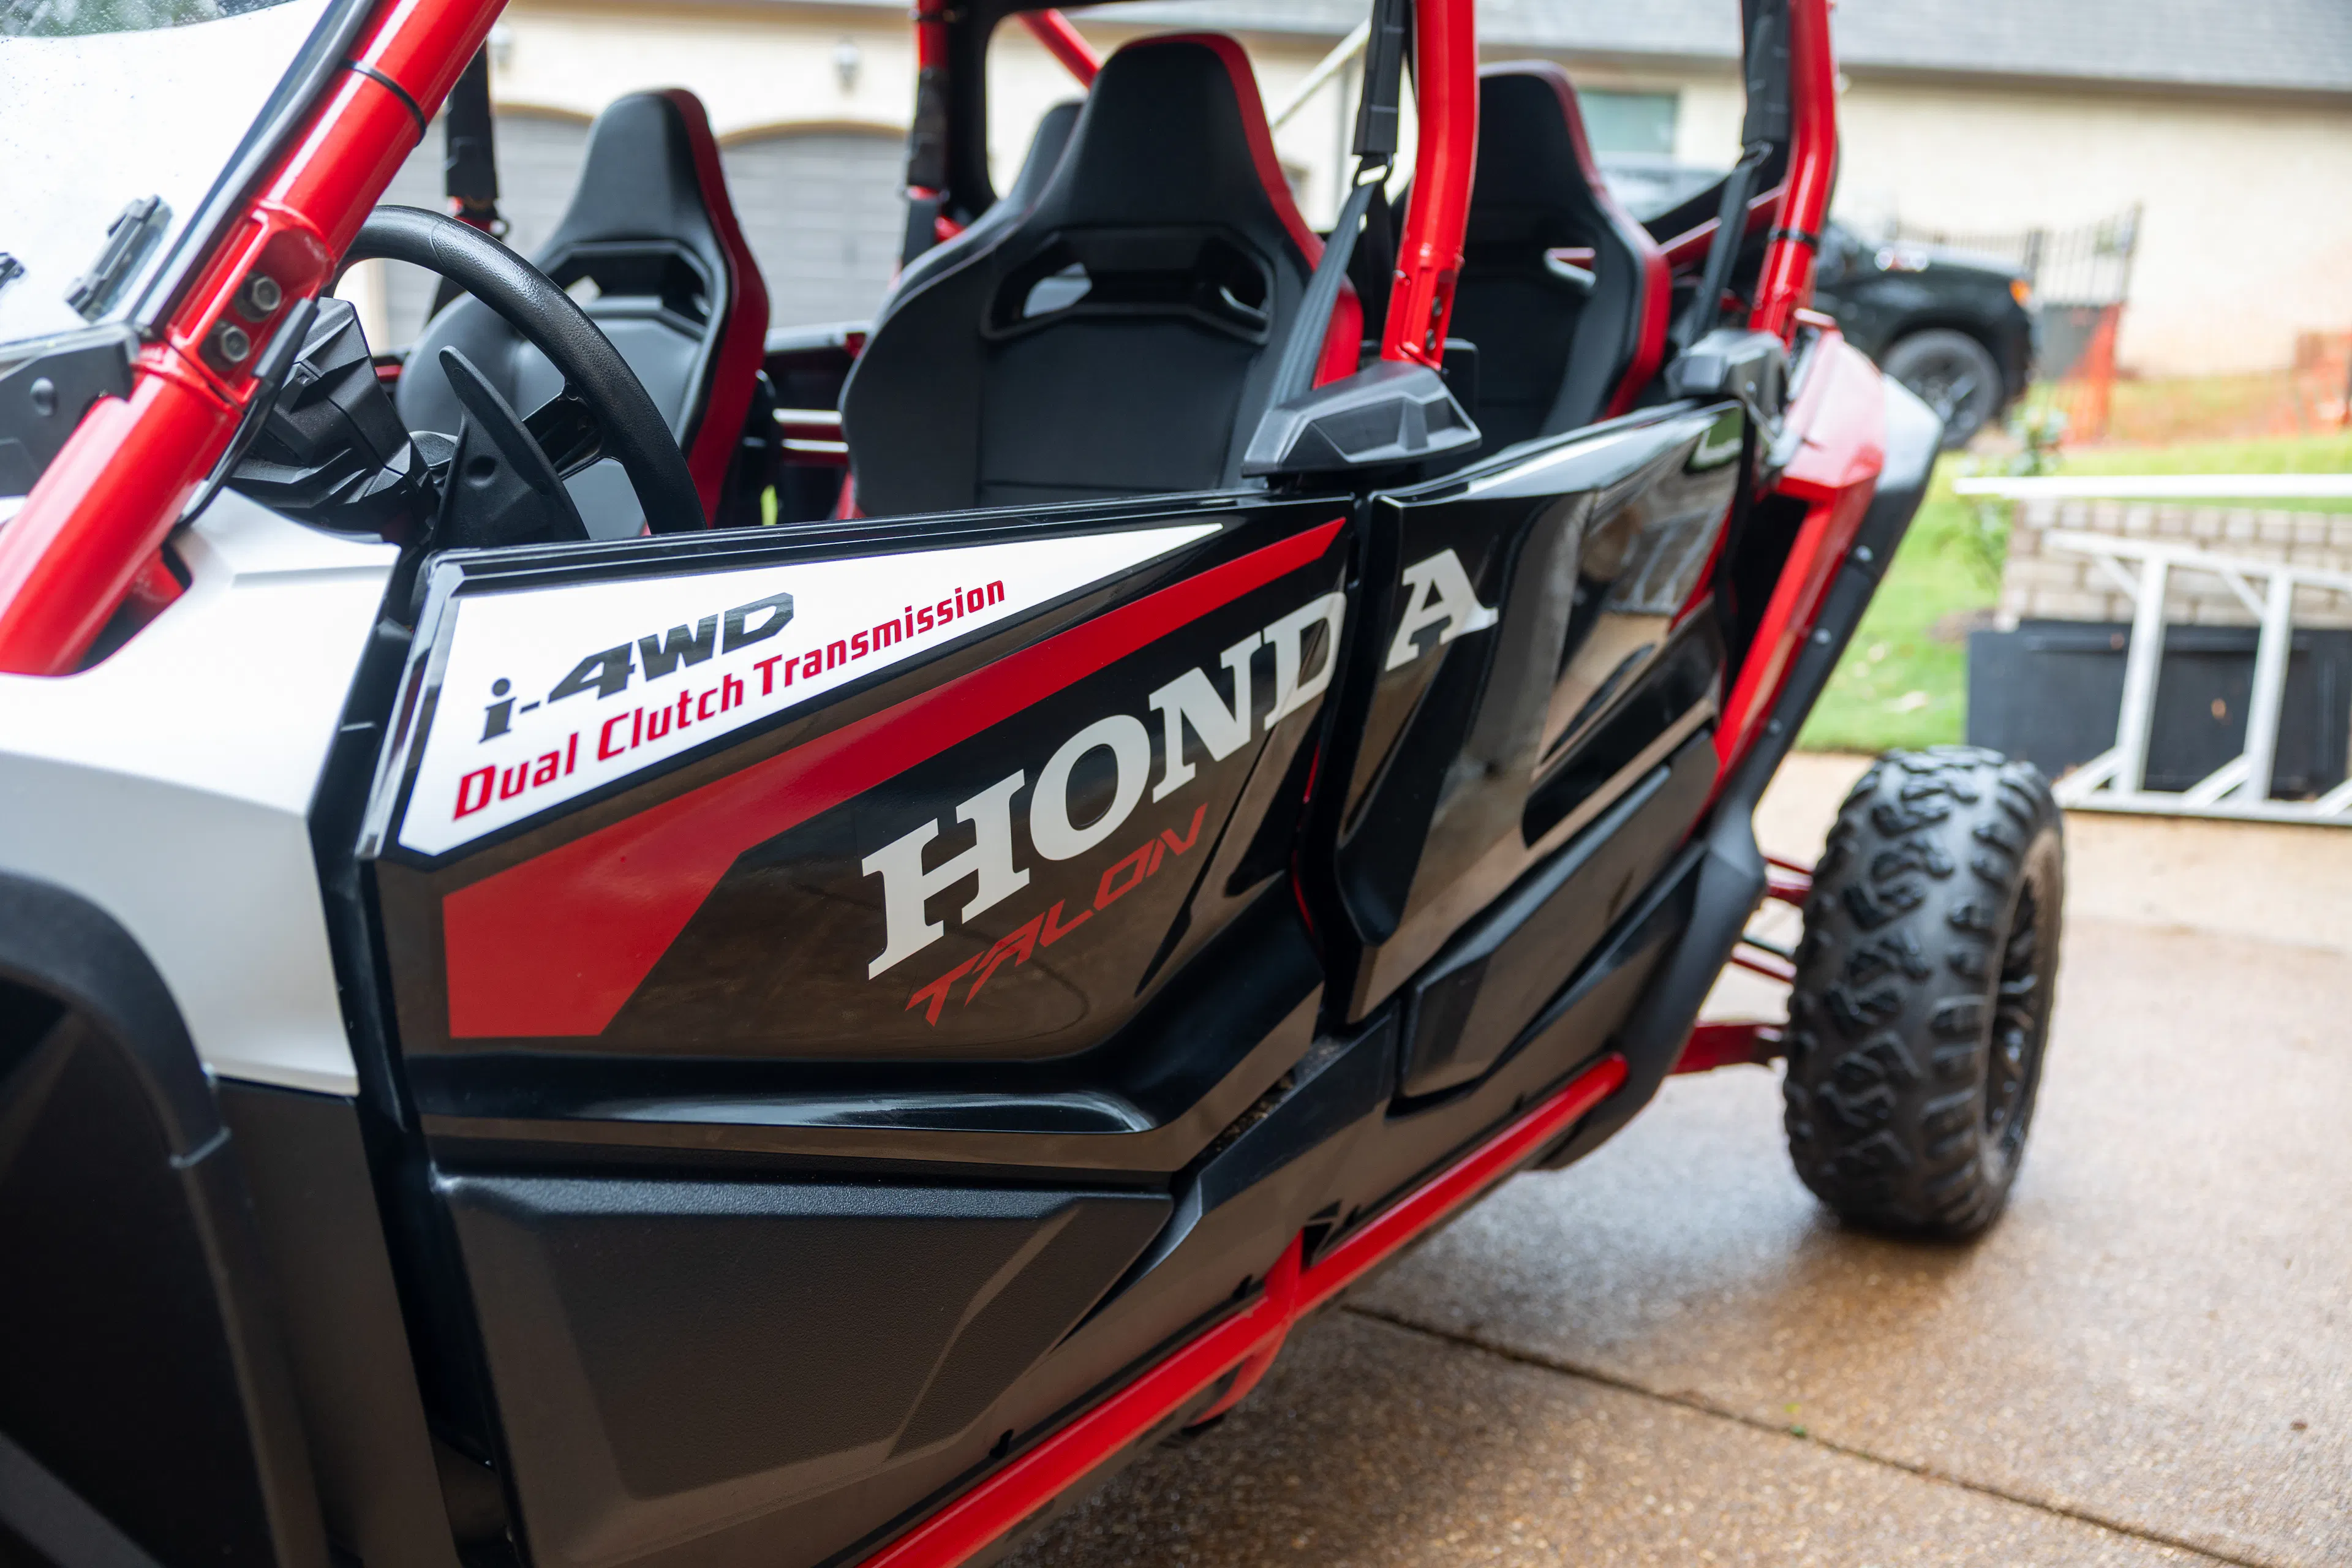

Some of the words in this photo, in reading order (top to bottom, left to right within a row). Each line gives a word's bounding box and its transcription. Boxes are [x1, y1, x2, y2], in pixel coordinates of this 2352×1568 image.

[453, 732, 578, 821] Dual
[597, 673, 744, 763] Clutch
[753, 579, 1005, 696] Transmission
[479, 592, 794, 743] i-4WD
[862, 548, 1499, 980] HONDA
[904, 802, 1208, 1028] TALON
